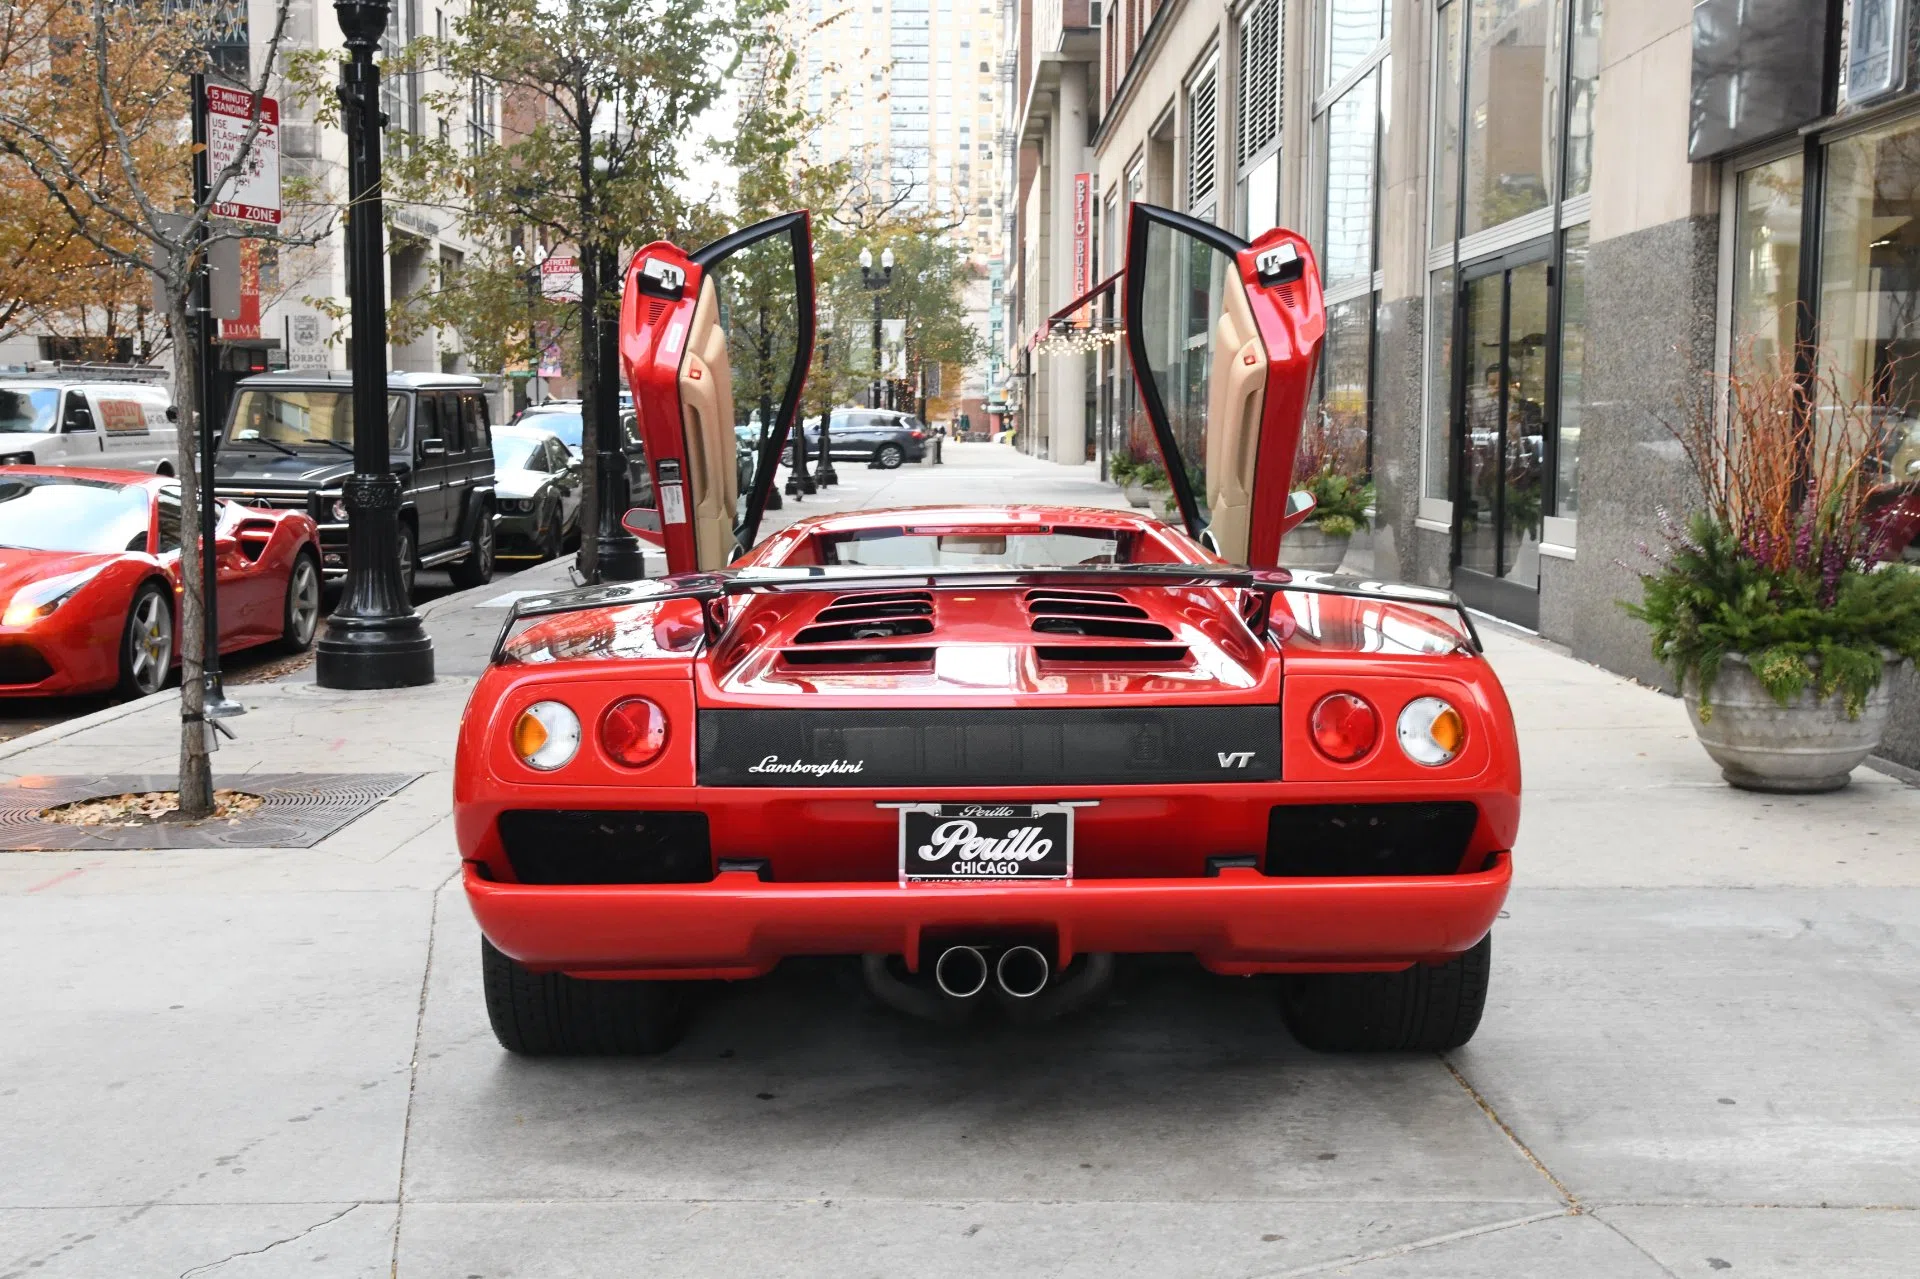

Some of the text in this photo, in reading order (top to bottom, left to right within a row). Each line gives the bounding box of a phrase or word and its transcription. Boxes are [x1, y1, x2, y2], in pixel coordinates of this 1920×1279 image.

[211, 89, 250, 105] 15 MINUTE
[211, 101, 249, 117] STANDING
[212, 118, 228, 130] USE
[213, 140, 221, 150] 10
[223, 142, 235, 152] AM
[213, 151, 231, 162] MON
[213, 161, 221, 172] 10
[215, 203, 276, 223] TOW ZONE
[1075, 180, 1086, 235] EPIC
[748, 755, 864, 778] Lamborghini
[1217, 751, 1256, 769] VT
[958, 804, 1014, 818] Perillo
[917, 819, 1053, 862] Perillo
[951, 861, 1020, 875] CHICAGO
